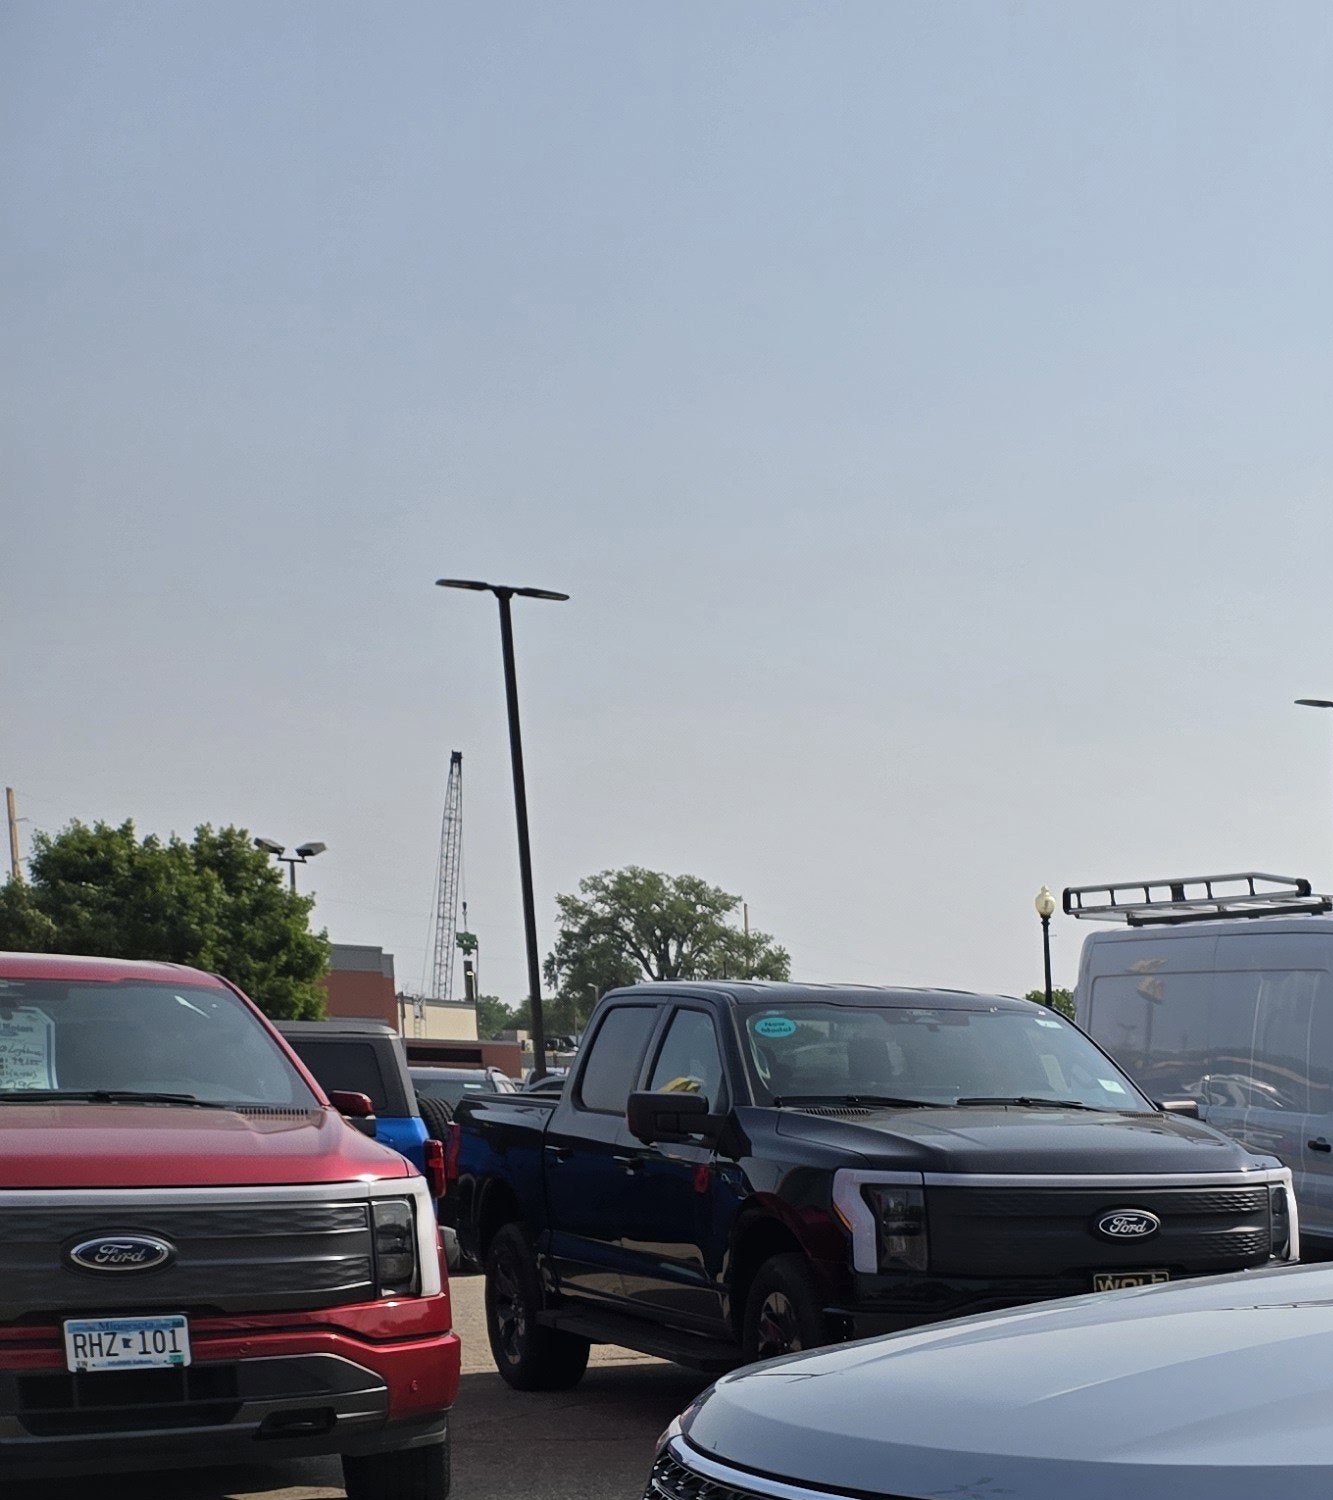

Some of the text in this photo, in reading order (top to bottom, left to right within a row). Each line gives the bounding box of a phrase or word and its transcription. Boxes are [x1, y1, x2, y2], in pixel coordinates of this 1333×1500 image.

[1110, 1216, 1147, 1233] Ford
[94, 1244, 146, 1263] Ford
[73, 1329, 182, 1358] RHZ 101
